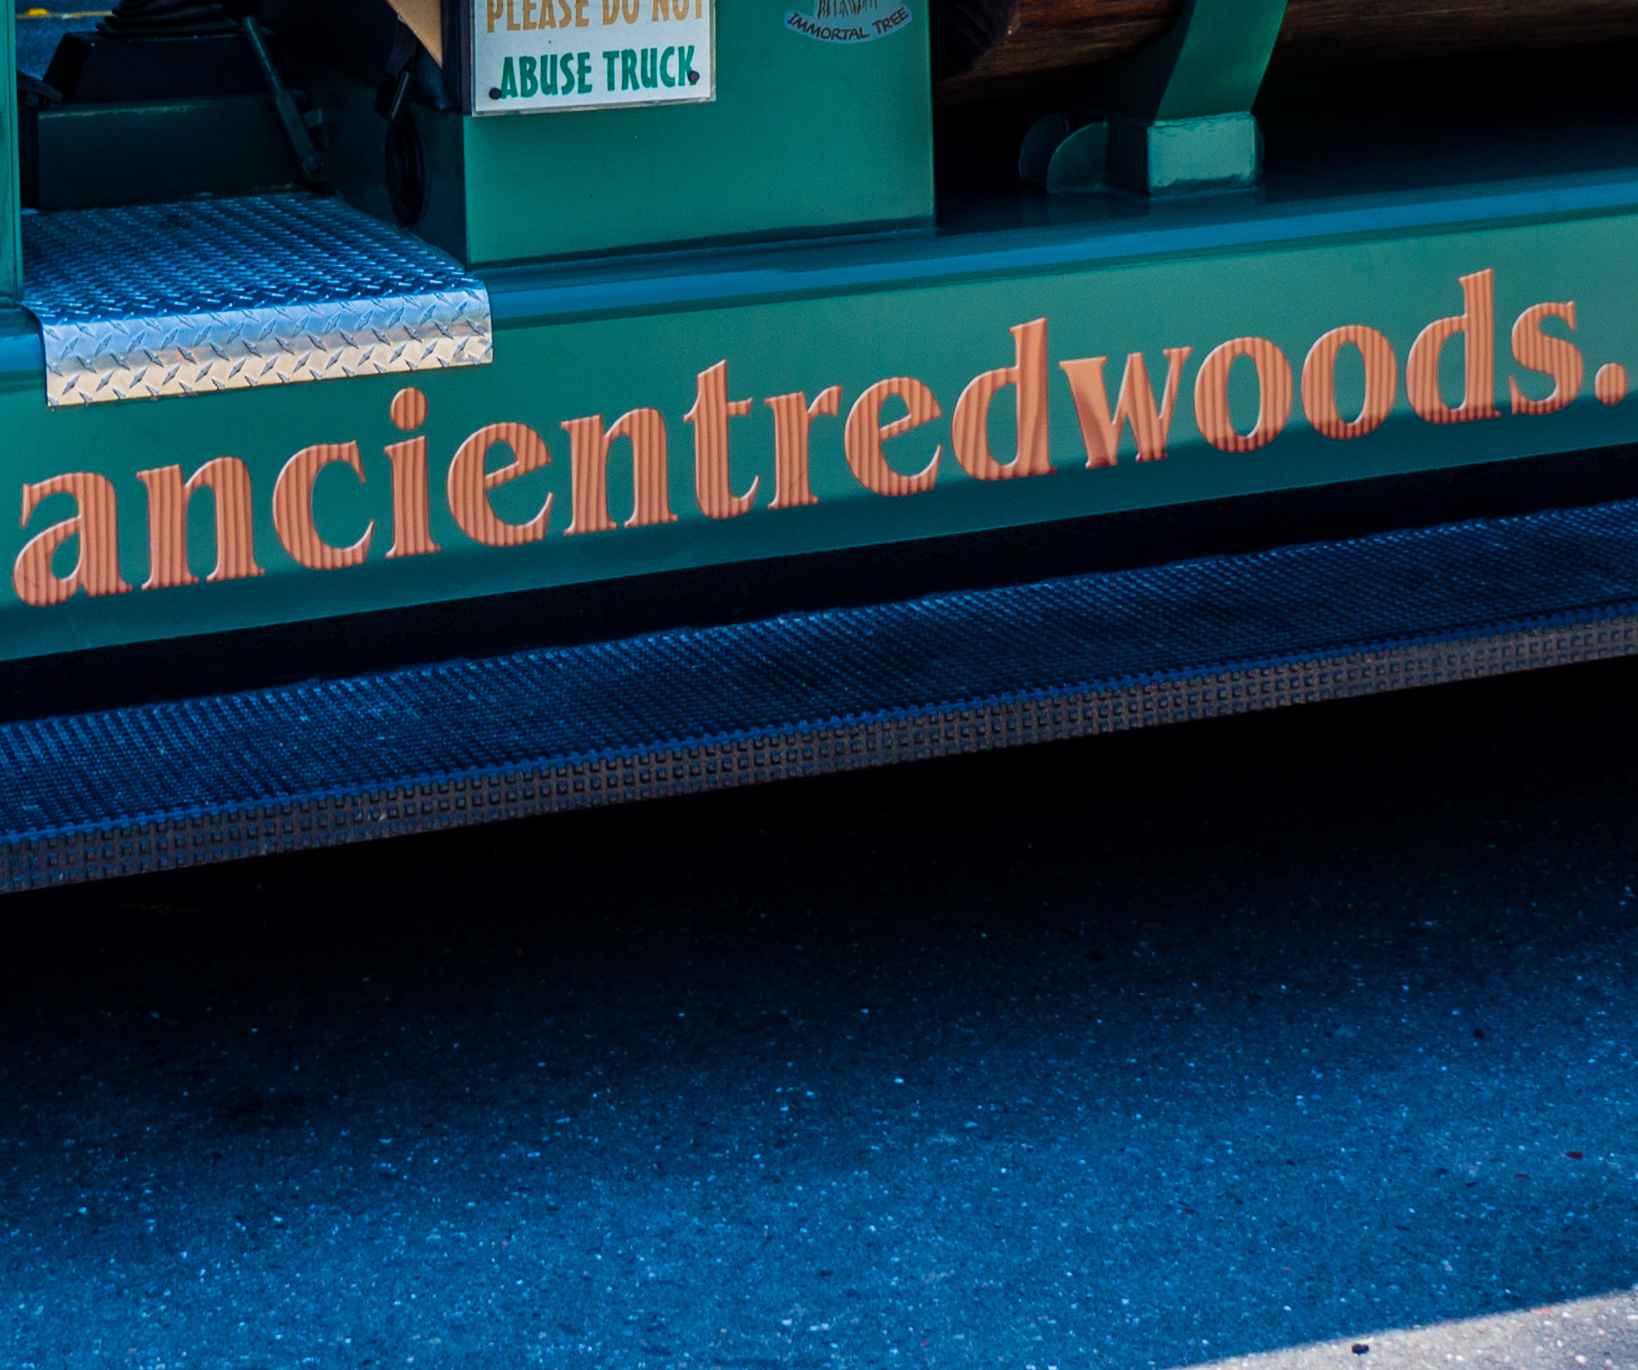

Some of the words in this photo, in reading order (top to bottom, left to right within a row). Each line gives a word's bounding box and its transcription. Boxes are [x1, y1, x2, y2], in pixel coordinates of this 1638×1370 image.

[786, 12, 870, 41] IMMORTAL
[872, 6, 910, 35] TREE
[500, 51, 593, 100] ABUSE
[602, 45, 698, 92] TRUCK
